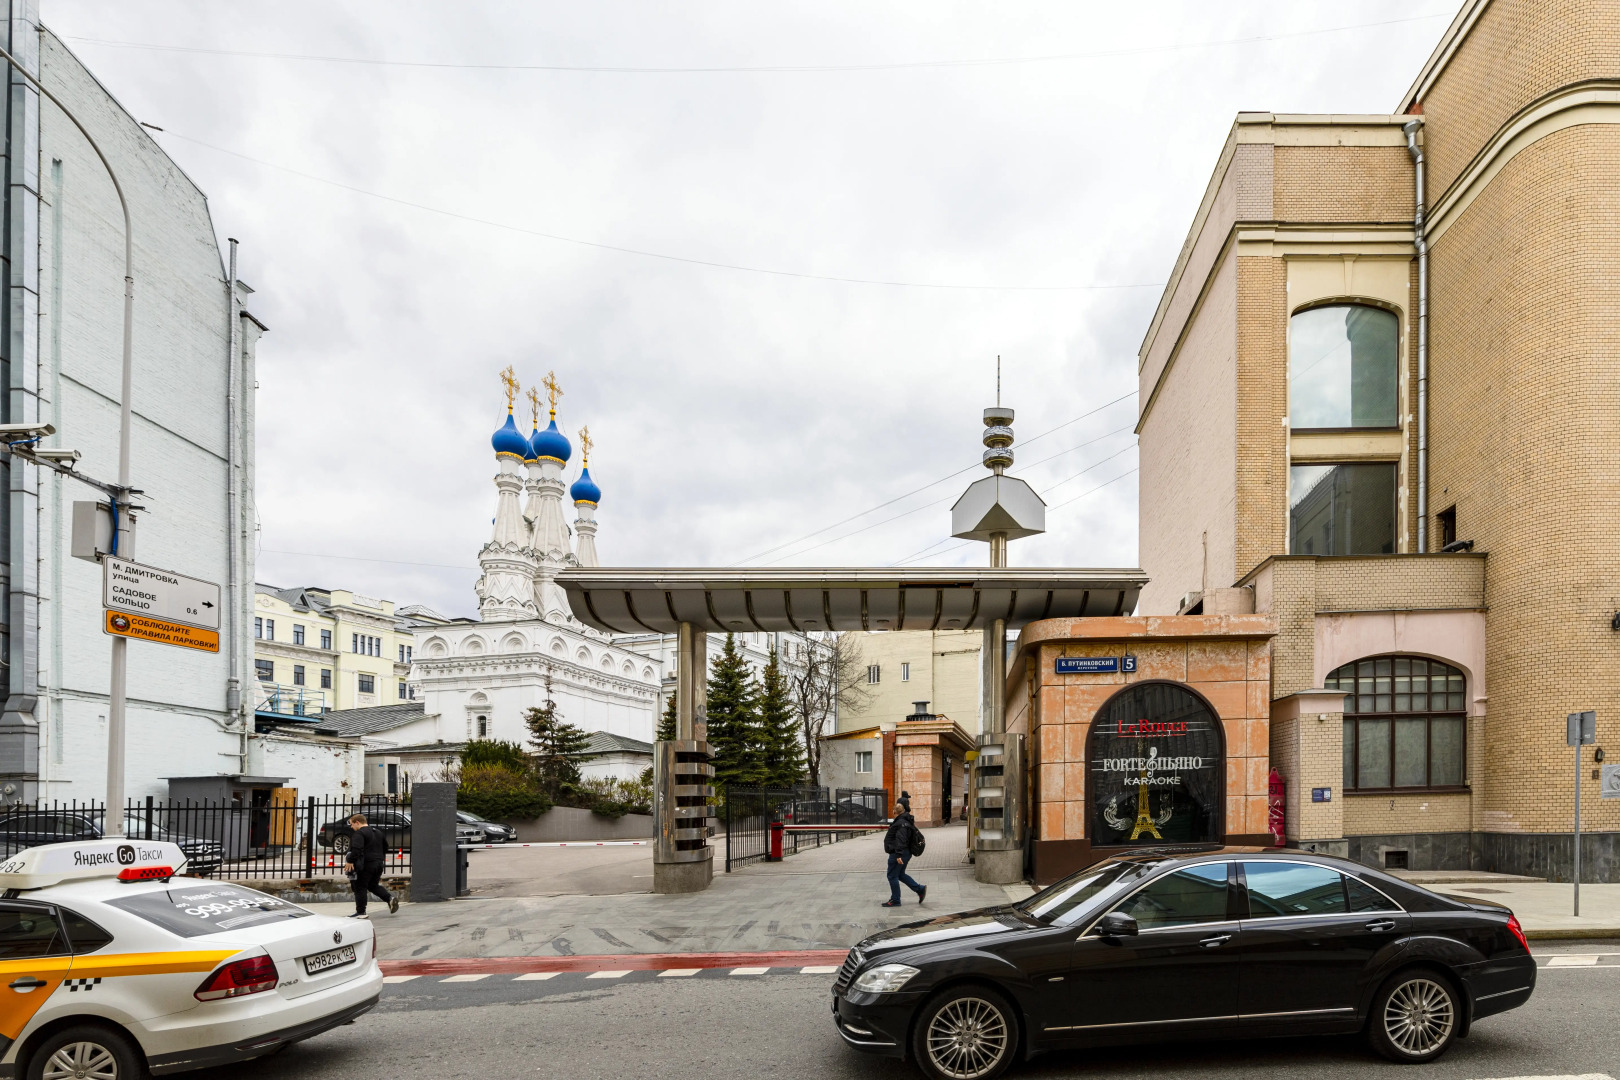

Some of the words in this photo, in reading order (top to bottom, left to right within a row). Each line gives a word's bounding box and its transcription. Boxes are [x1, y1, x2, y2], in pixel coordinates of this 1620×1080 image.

[112, 563, 122, 572] М.
[124, 566, 178, 585] ДМИТРОВКА
[112, 574, 139, 584] улица
[112, 586, 156, 601] САДОВОЕ
[112, 596, 150, 610] КОЛЬЦО
[132, 618, 190, 636] СОБЛЮДАЙТЕ
[131, 628, 170, 641] ПРАВИЛА
[173, 636, 216, 648] ПАРКОВКИ!
[1126, 658, 1134, 670] 5
[1118, 720, 1136, 733] Le
[1124, 776, 1182, 786] KARAOKE
[74, 850, 114, 866] Яндекс
[118, 850, 134, 862] Go
[136, 848, 163, 860] Такси
